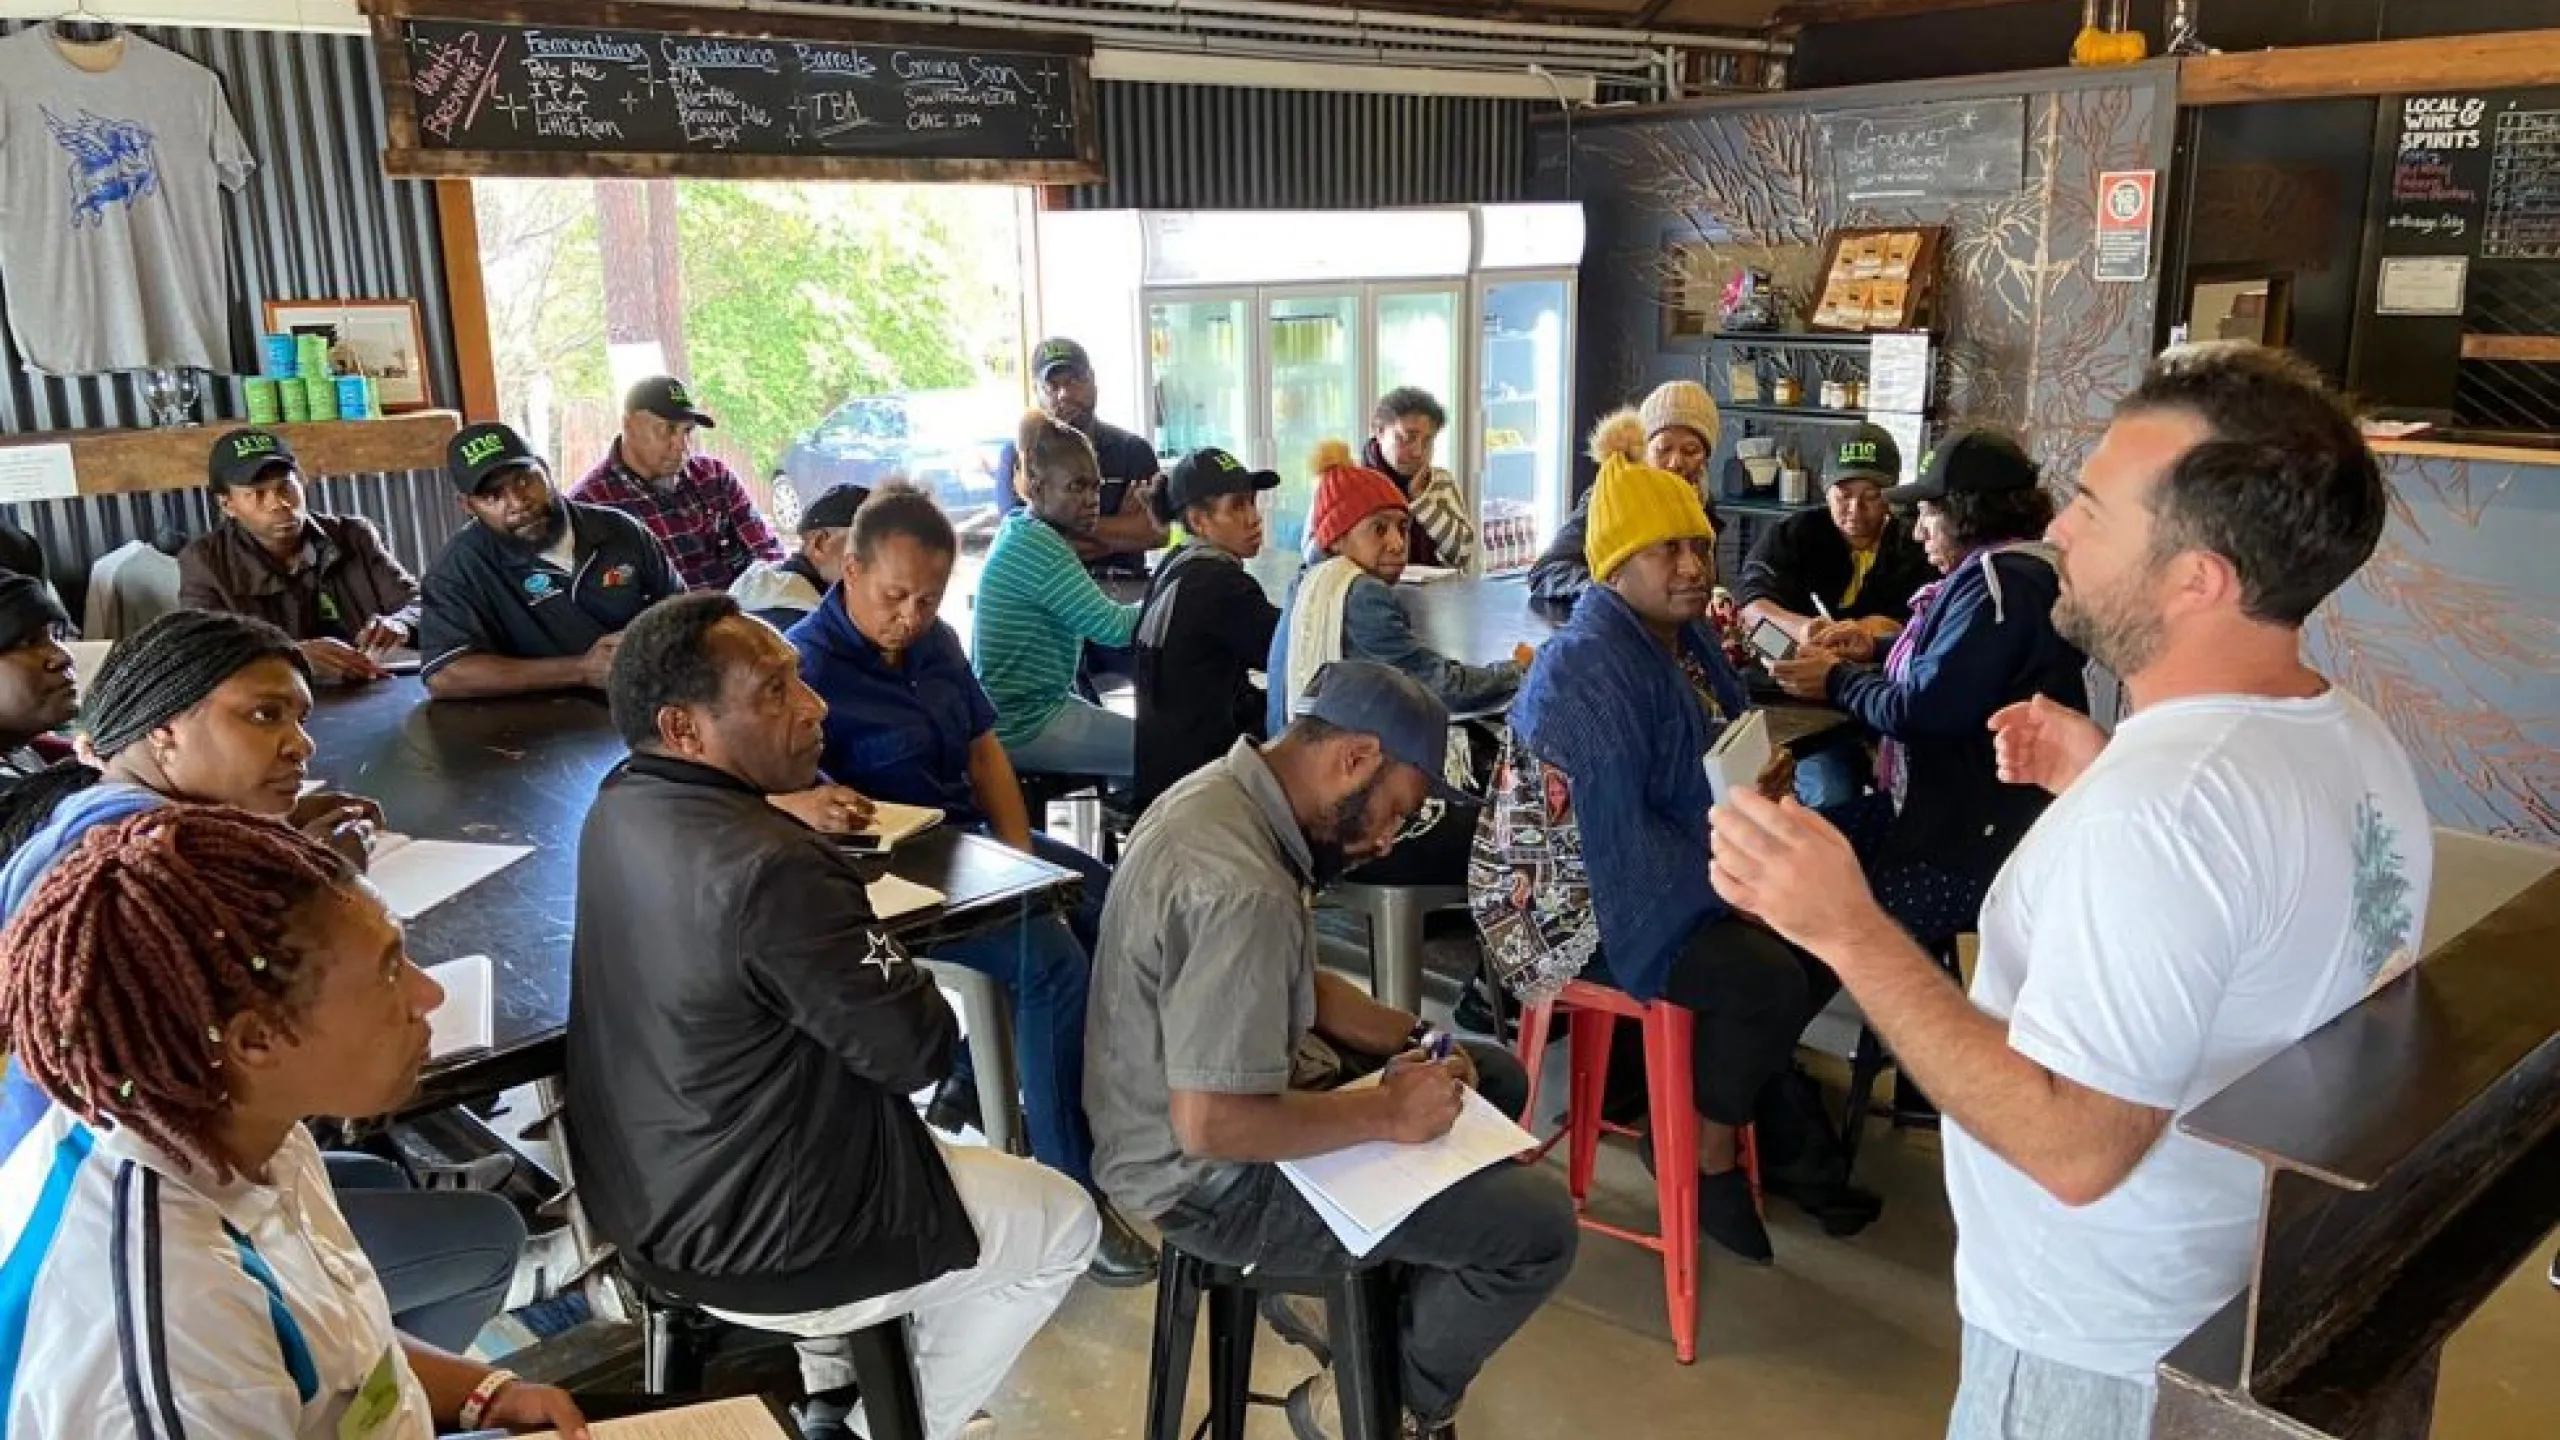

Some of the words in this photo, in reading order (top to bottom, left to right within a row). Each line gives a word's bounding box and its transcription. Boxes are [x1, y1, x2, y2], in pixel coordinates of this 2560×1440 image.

[2405, 98, 2459, 113] LOCAL
[2403, 112, 2457, 130] WINE
[2399, 129, 2480, 152] SPIRITS
